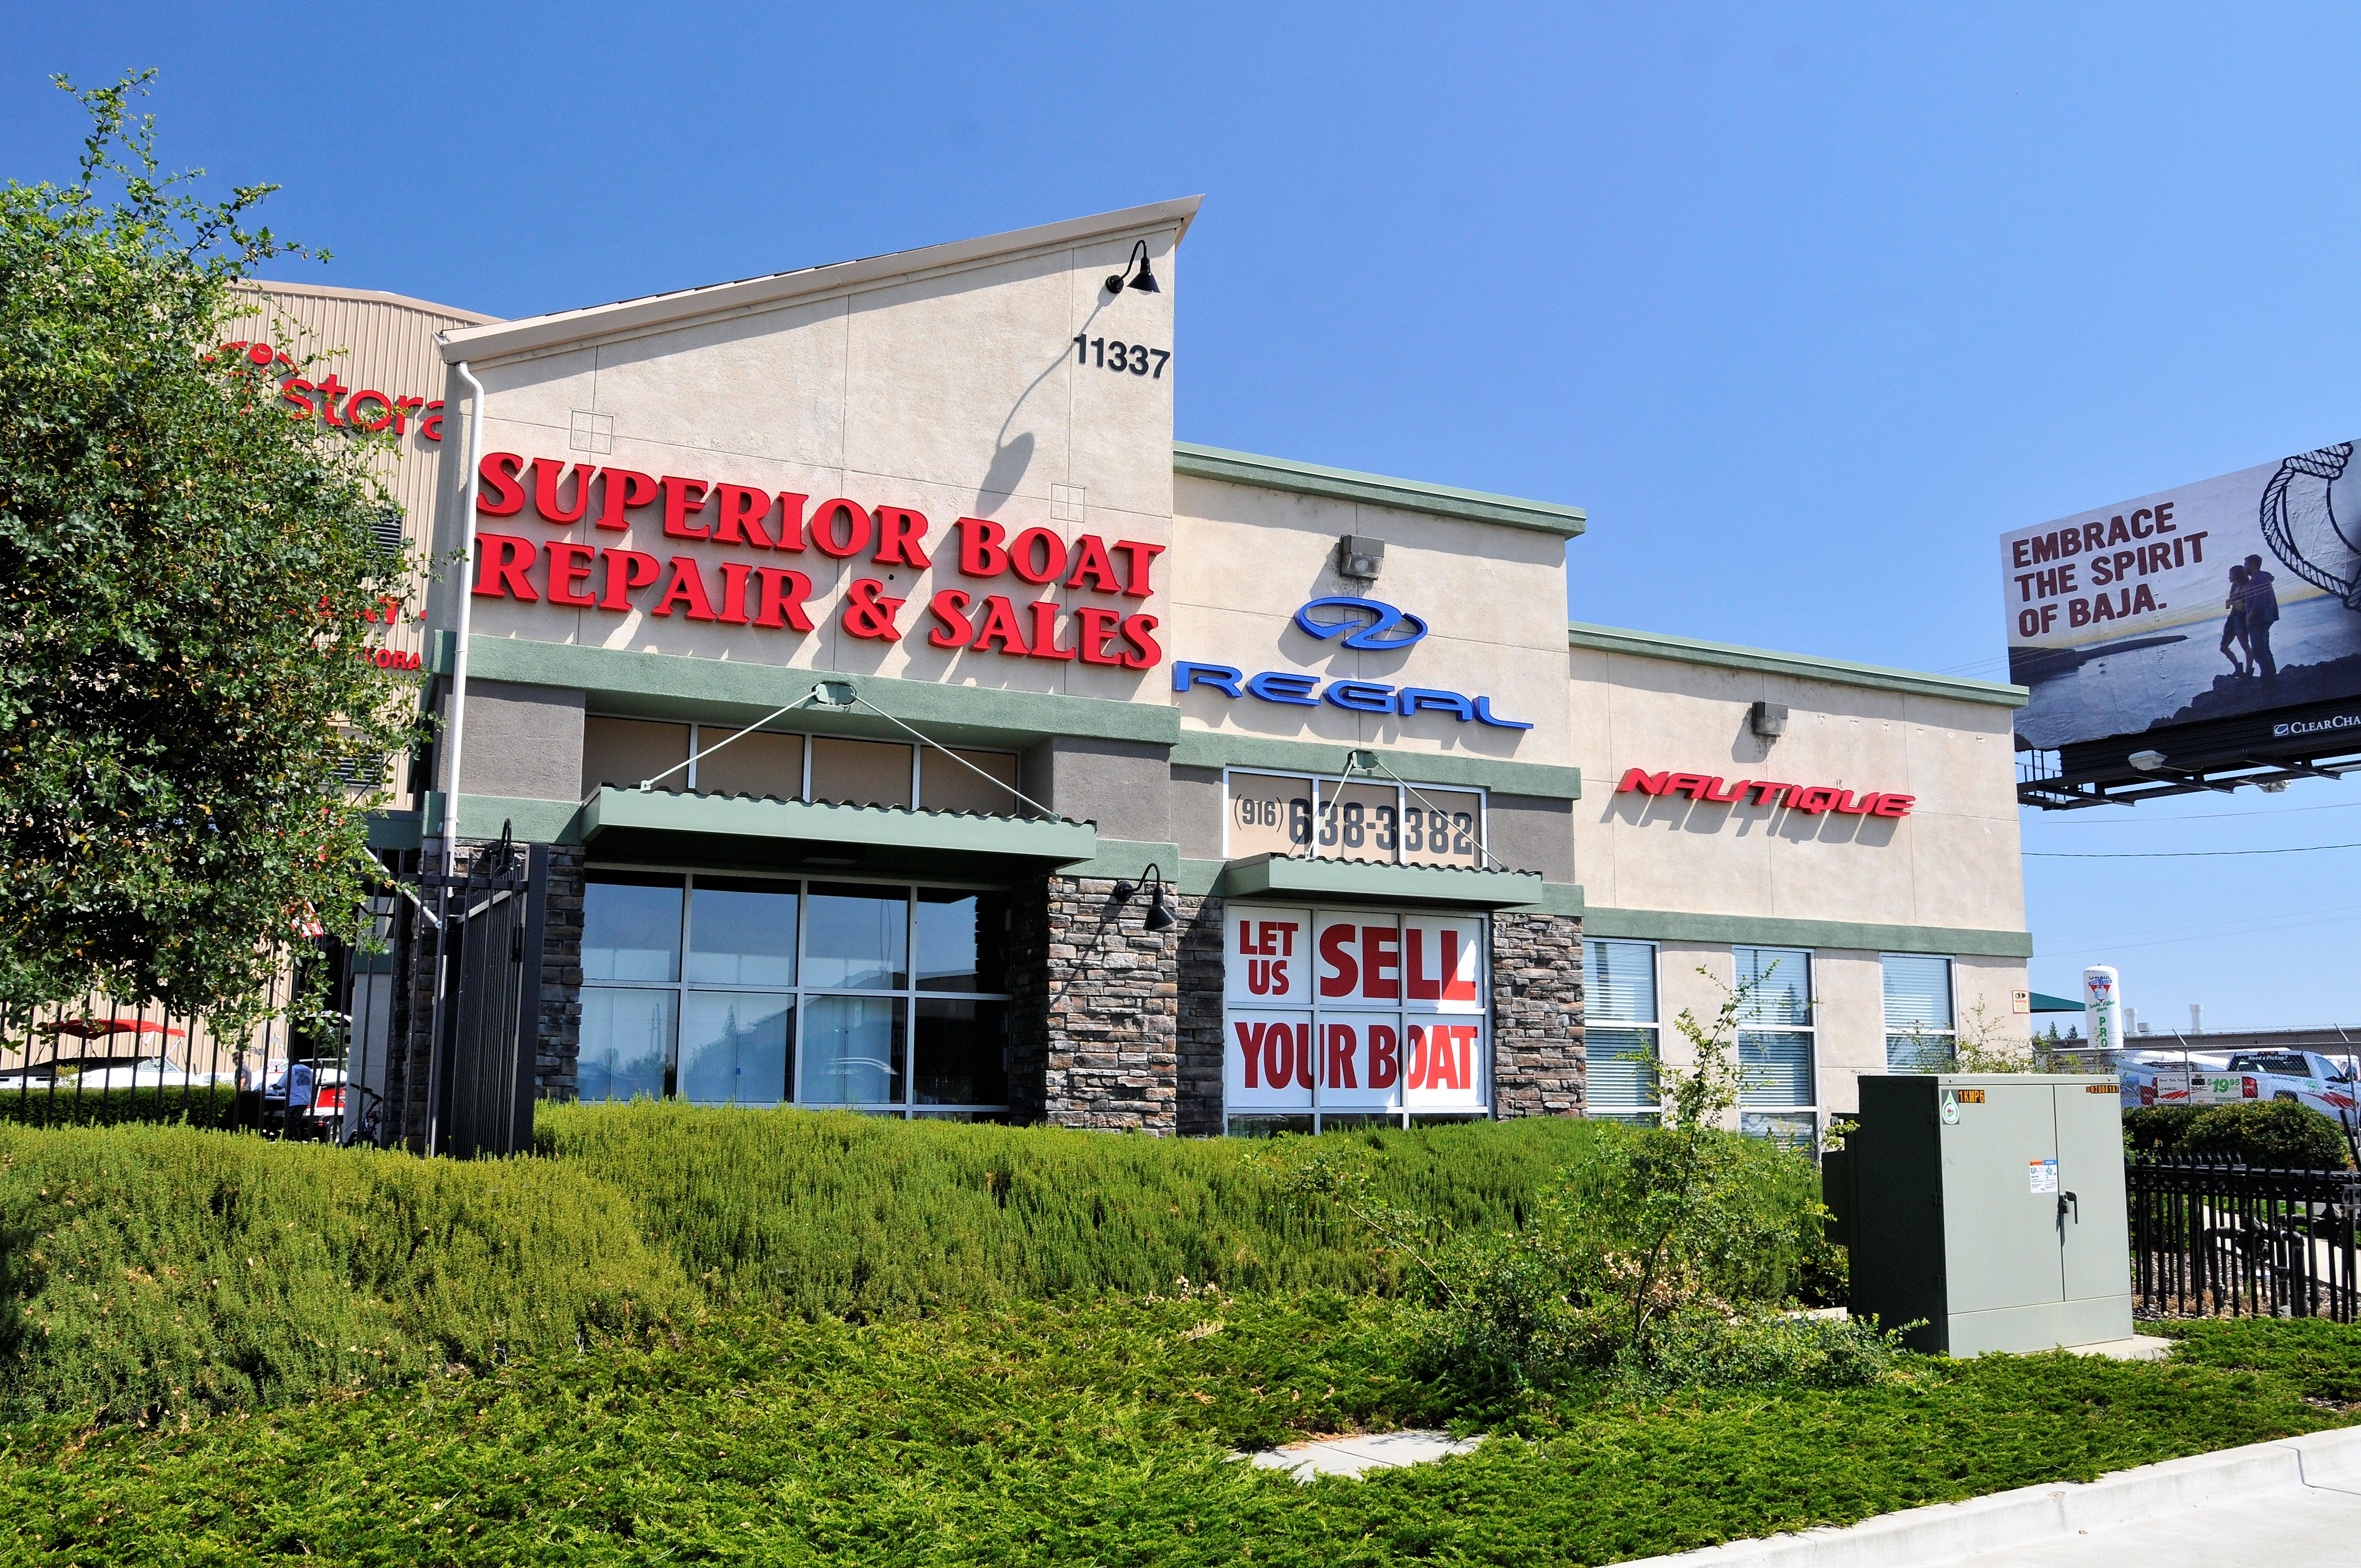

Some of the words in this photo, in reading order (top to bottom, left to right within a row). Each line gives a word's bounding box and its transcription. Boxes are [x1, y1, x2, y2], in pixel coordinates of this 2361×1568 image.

[1073, 333, 1171, 379] 11337
[476, 451, 932, 571] SUPERIOR
[954, 516, 1166, 600] BOAT
[2012, 502, 2177, 568] EMBRACE
[2015, 563, 2079, 602] THE
[2091, 531, 2208, 586] SPIRIT
[472, 532, 815, 634] REPAIR
[841, 578, 907, 643] &
[928, 589, 1162, 671] SALES
[2019, 603, 2058, 638] OF
[2068, 584, 2168, 629] BAJA.
[1172, 660, 1535, 730] REGAL
[1234, 793, 1283, 834] (916)
[1288, 798, 1473, 856] 638-3382
[1615, 767, 1917, 819] NAUTIQUE
[1239, 920, 1298, 956] LET
[1319, 924, 1476, 1001] SELL
[1248, 960, 1290, 995] US
[1234, 1021, 1358, 1090] YOUR
[1368, 1024, 1478, 1090] BOAT
[1959, 1090, 1985, 1103] 1KMP6
